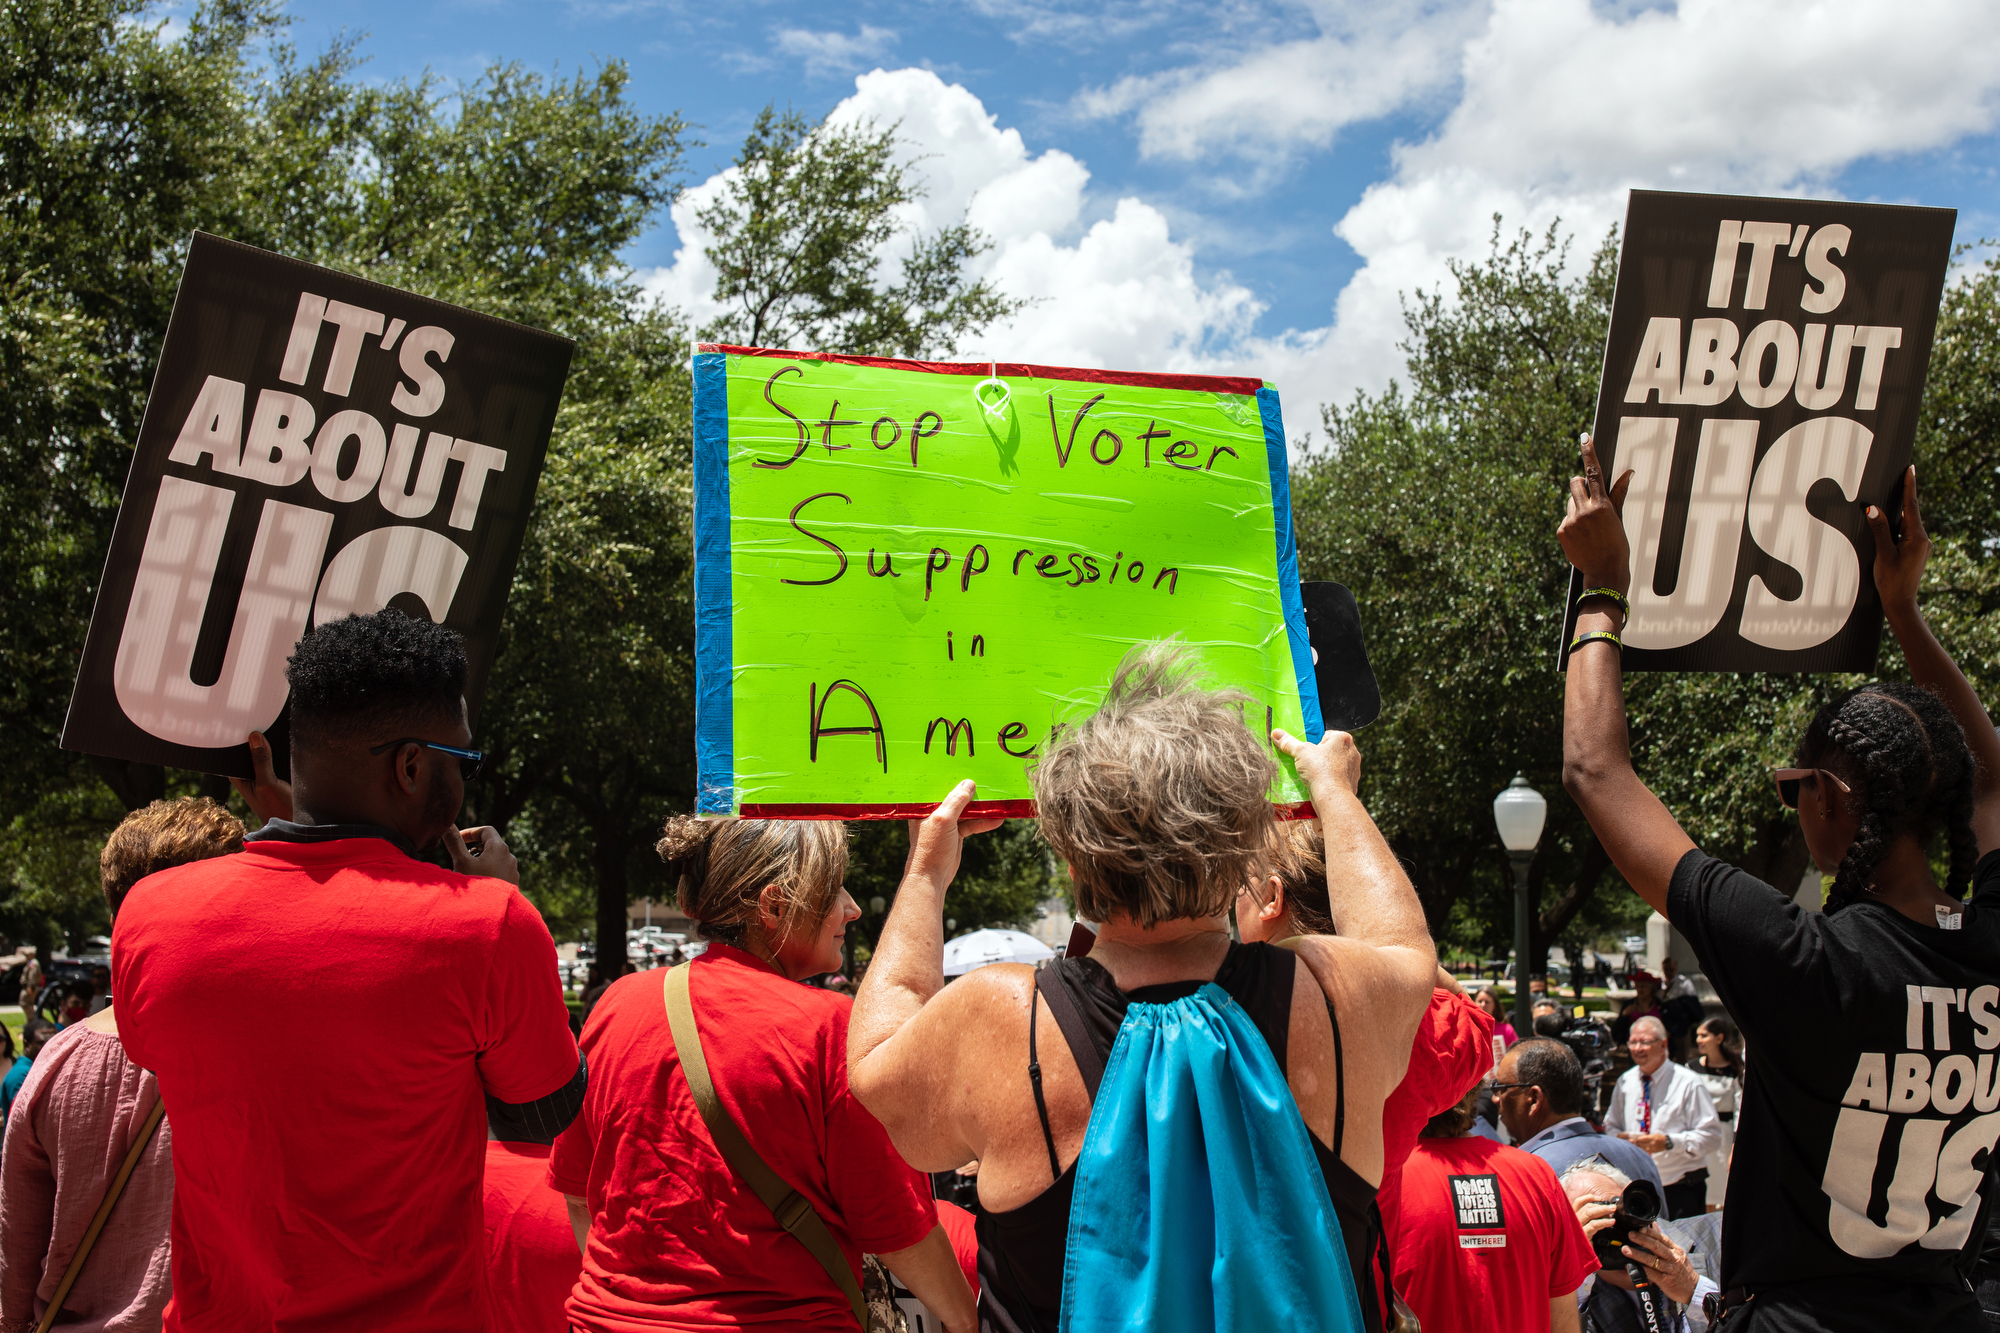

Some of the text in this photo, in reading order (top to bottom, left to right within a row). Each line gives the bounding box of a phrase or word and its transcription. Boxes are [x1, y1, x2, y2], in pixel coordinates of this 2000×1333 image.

[1706, 219, 1852, 314] IT'S
[278, 291, 456, 417] IT'S
[1623, 317, 1902, 411] ABOUT
[168, 374, 508, 531] ABOUT
[751, 365, 1240, 473] Stop Voter
[780, 491, 1180, 602] Suppression
[1610, 416, 1875, 651] US
[945, 630, 985, 662] in
[1906, 984, 2000, 1051] IT'S
[1840, 1052, 2000, 1115] ABOU
[1457, 1194, 1497, 1210] VOTERS
[1459, 1208, 1498, 1225] MATTER
[1641, 1291, 1659, 1333] SONY
